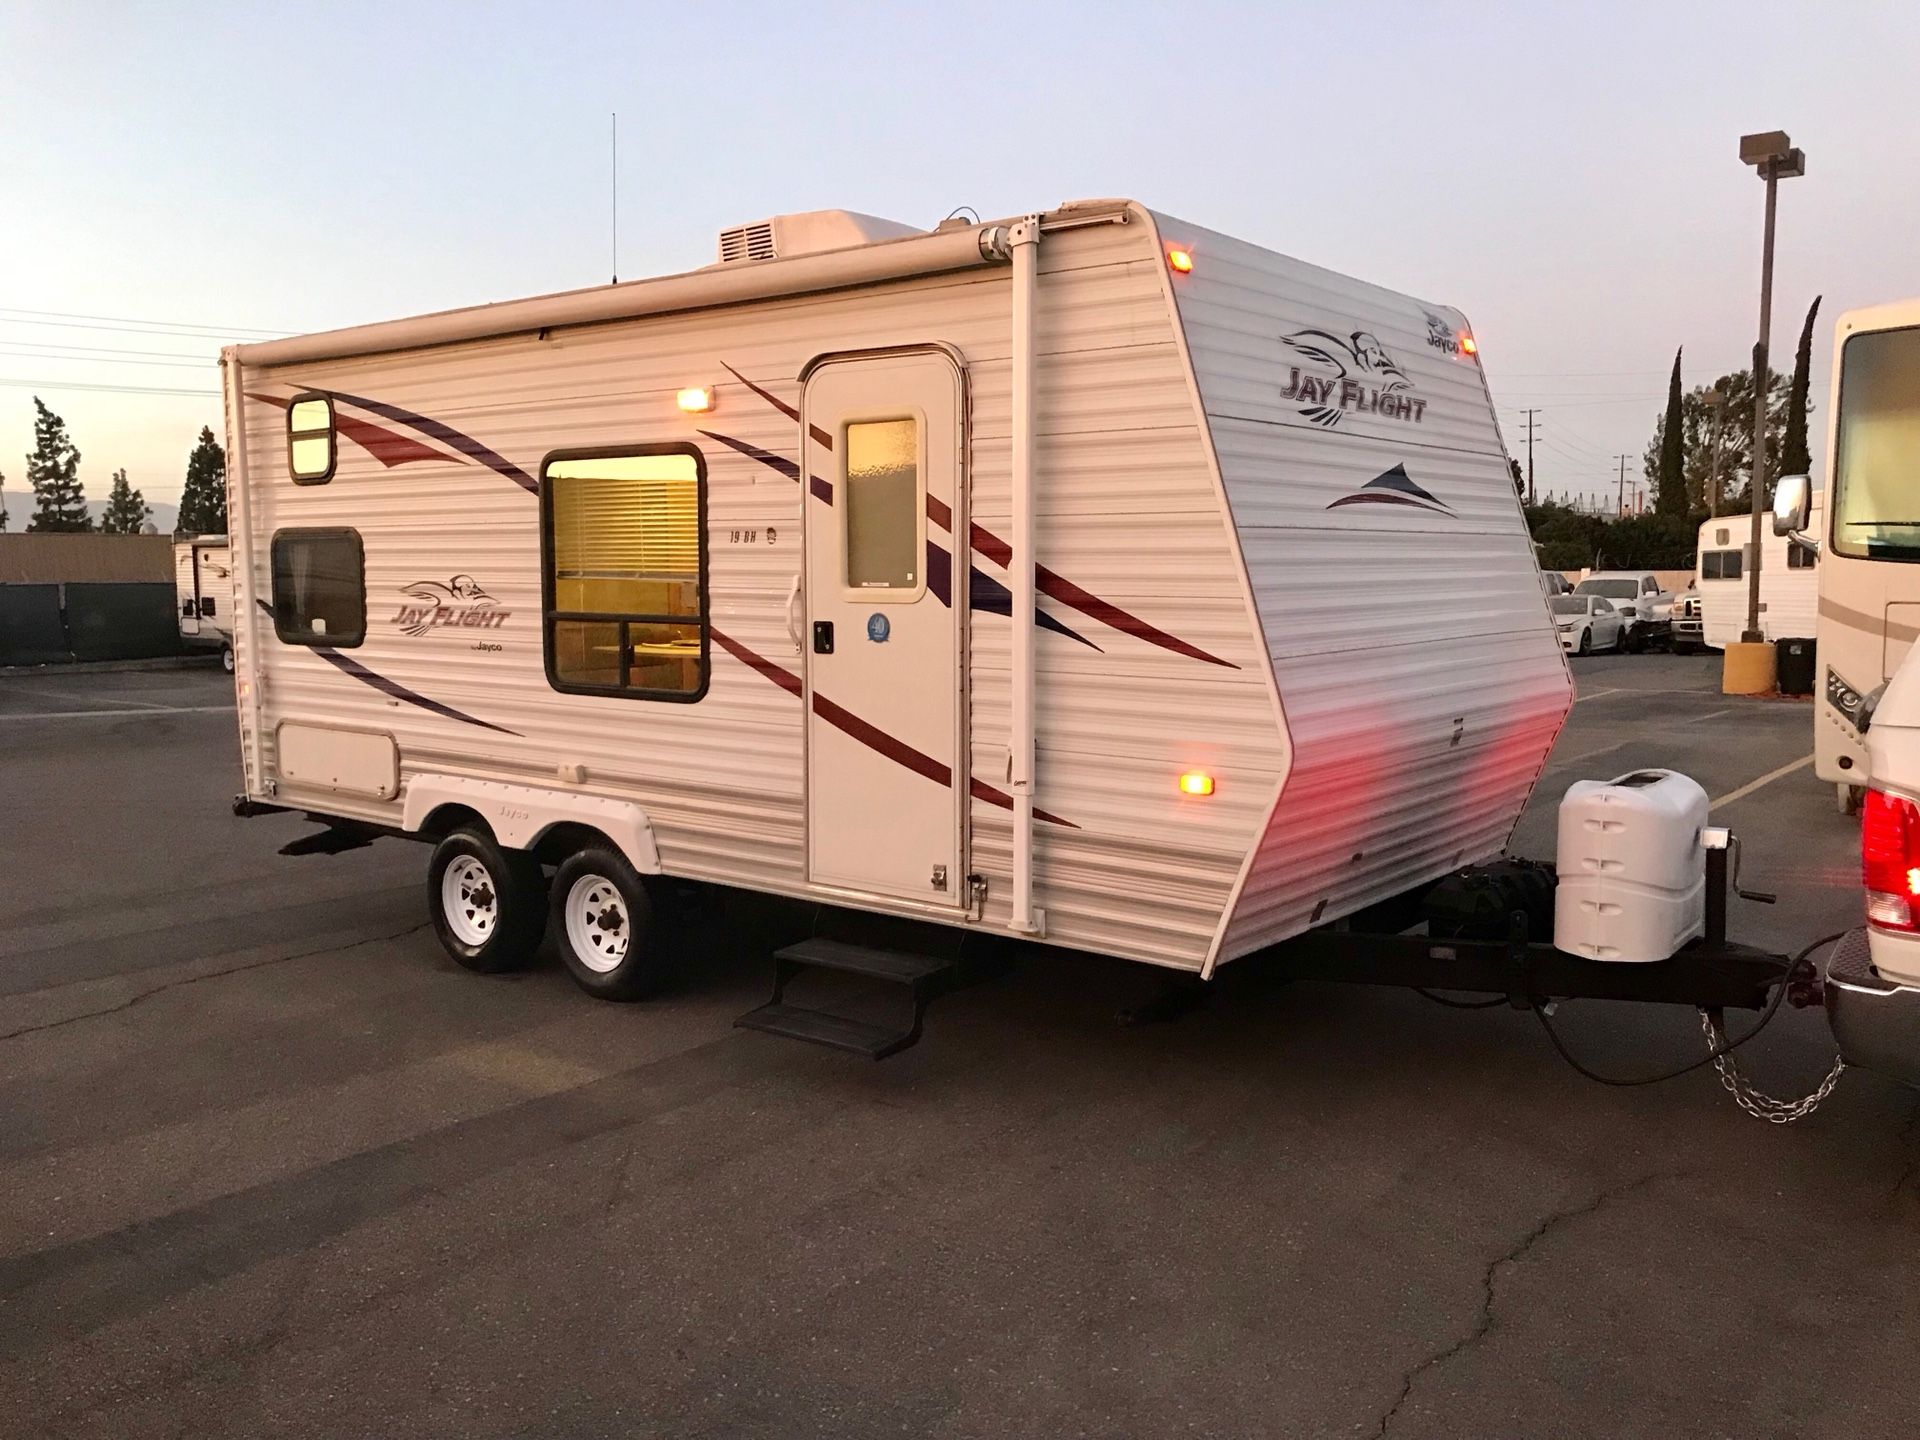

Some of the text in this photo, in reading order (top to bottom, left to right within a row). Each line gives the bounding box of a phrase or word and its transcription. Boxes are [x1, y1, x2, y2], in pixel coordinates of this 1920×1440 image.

[1427, 329, 1460, 354] Jayco
[1280, 367, 1428, 423] JAY FLIGHT
[730, 530, 757, 543] 19 BH
[390, 604, 512, 628] JAY FLIGHT
[477, 641, 503, 652] Jayco
